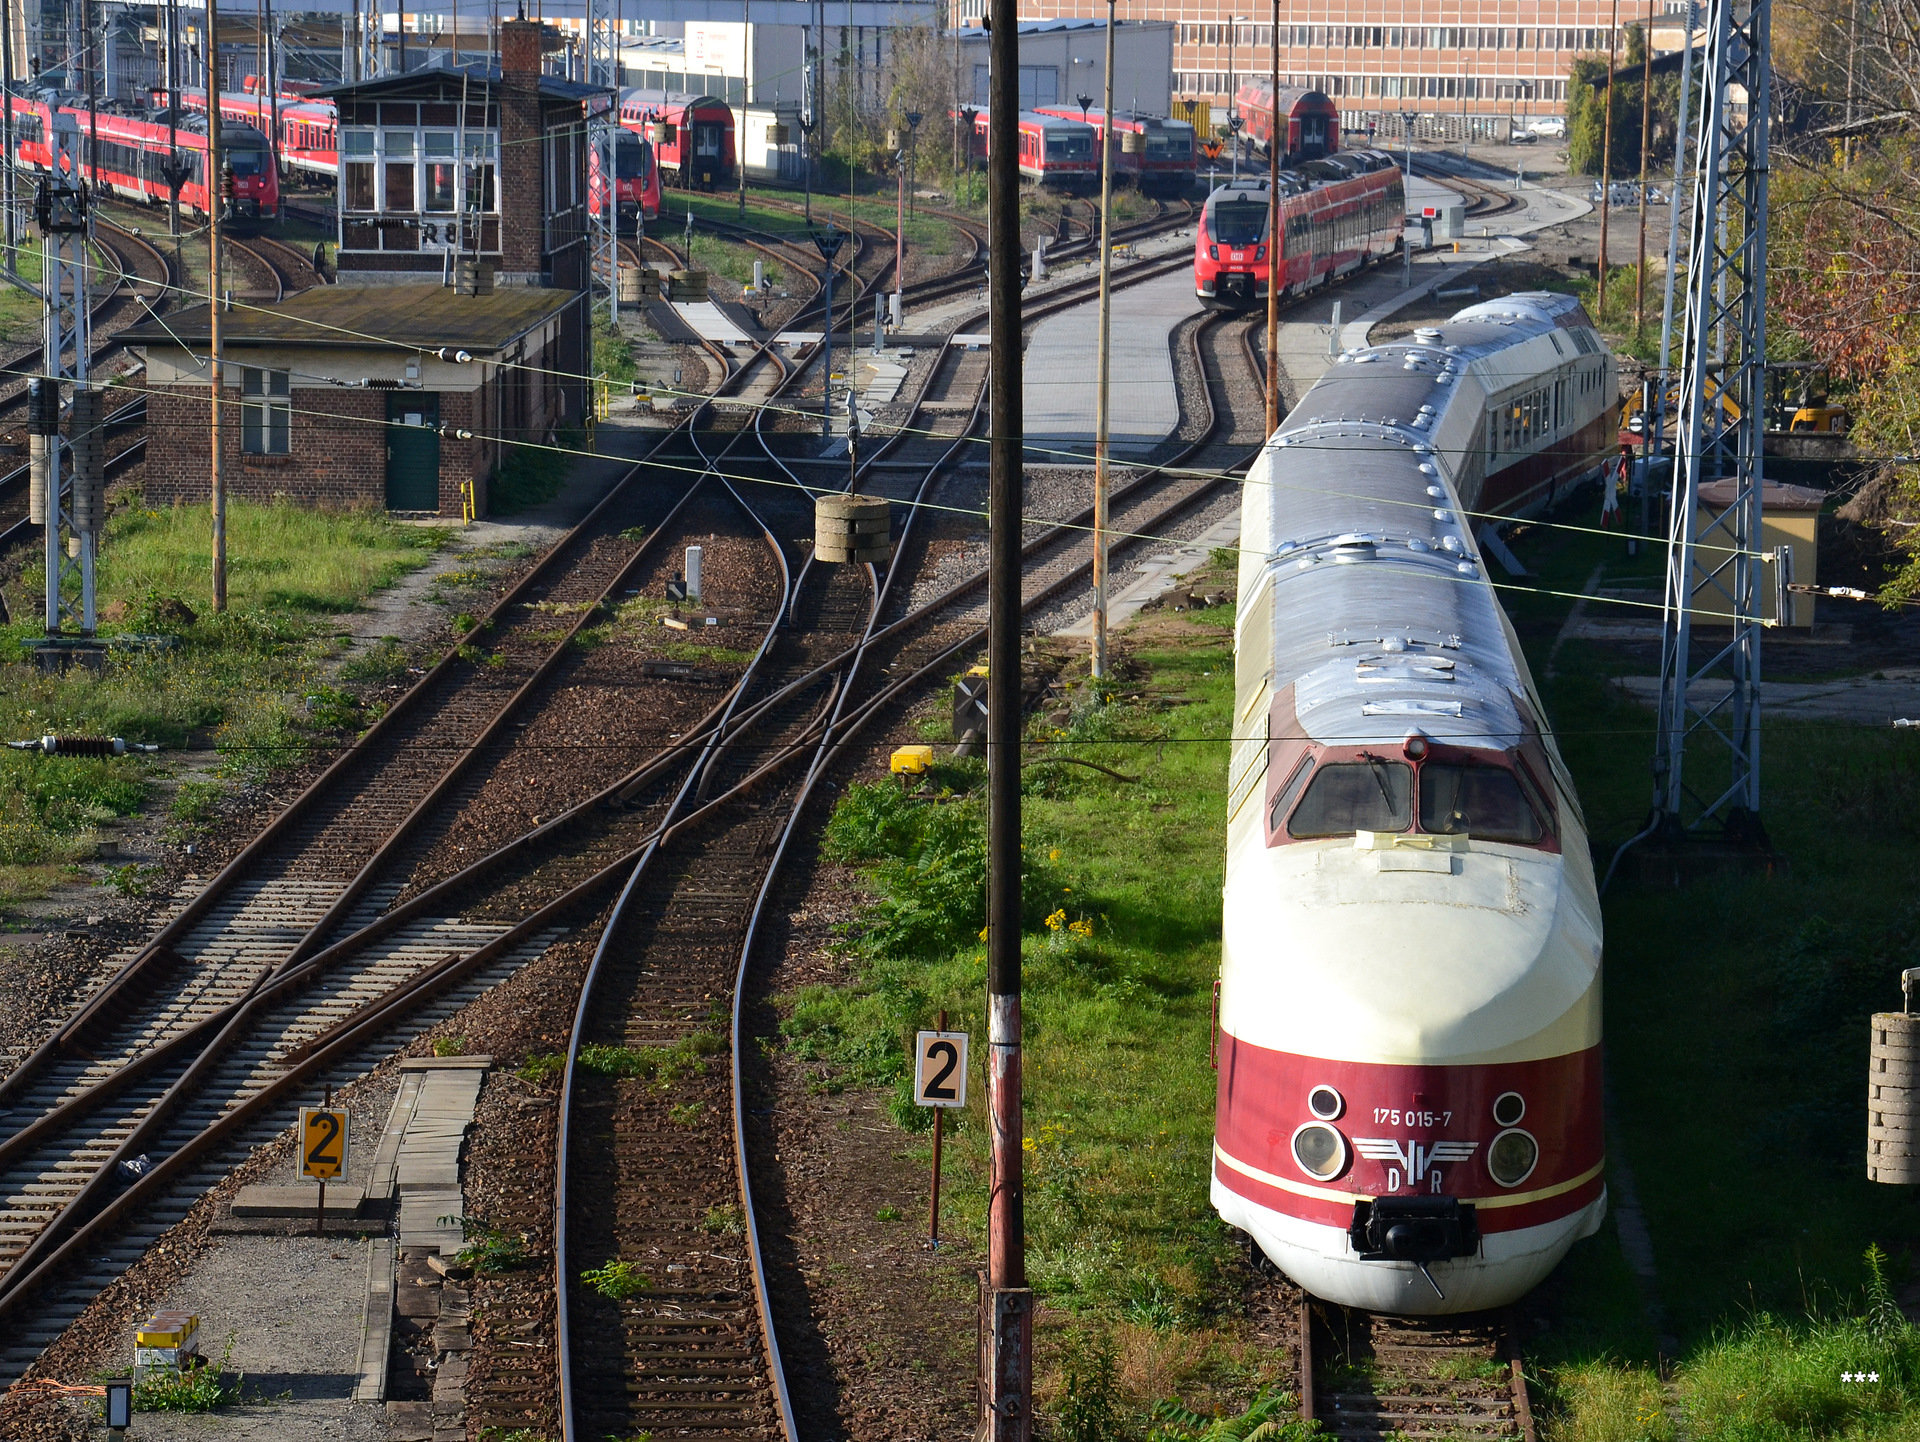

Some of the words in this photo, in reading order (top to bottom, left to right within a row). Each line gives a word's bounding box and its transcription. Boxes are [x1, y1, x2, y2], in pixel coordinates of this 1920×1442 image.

[422, 223, 437, 243] R
[445, 222, 456, 243] 8
[923, 1041, 957, 1099] 2
[1373, 1108, 1401, 1126] 175
[1405, 1110, 1453, 1127] 015-7
[307, 1113, 340, 1164] 2
[1388, 1167, 1400, 1193] D
[1430, 1169, 1442, 1194] R
